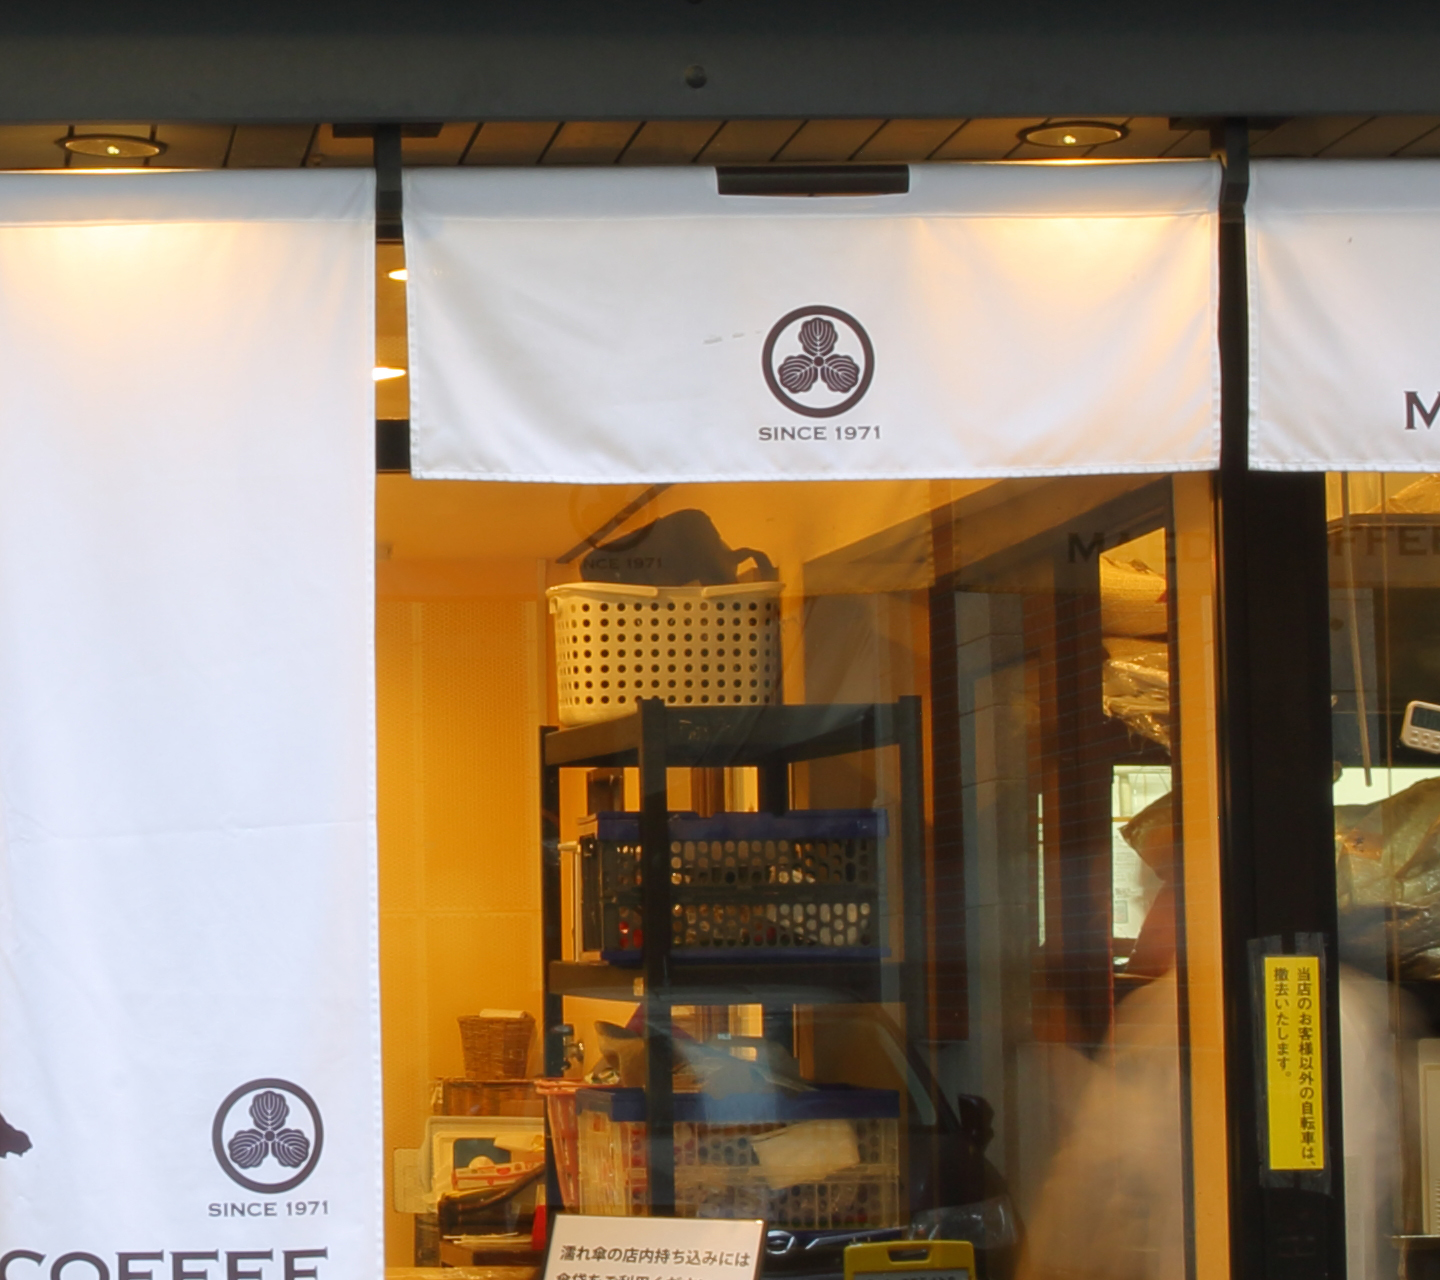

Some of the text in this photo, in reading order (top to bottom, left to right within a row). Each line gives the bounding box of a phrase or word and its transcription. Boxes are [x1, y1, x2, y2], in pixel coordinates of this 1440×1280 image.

[758, 425, 881, 441] SINCE 1971
[1273, 966, 1292, 1078] 撤去いたします。
[1296, 966, 1317, 1167] 当店のお客様以外の自転車は、
[207, 1200, 330, 1218] SINCE 1971
[560, 1245, 751, 1267] 濡れ傘の店内持ち込みには
